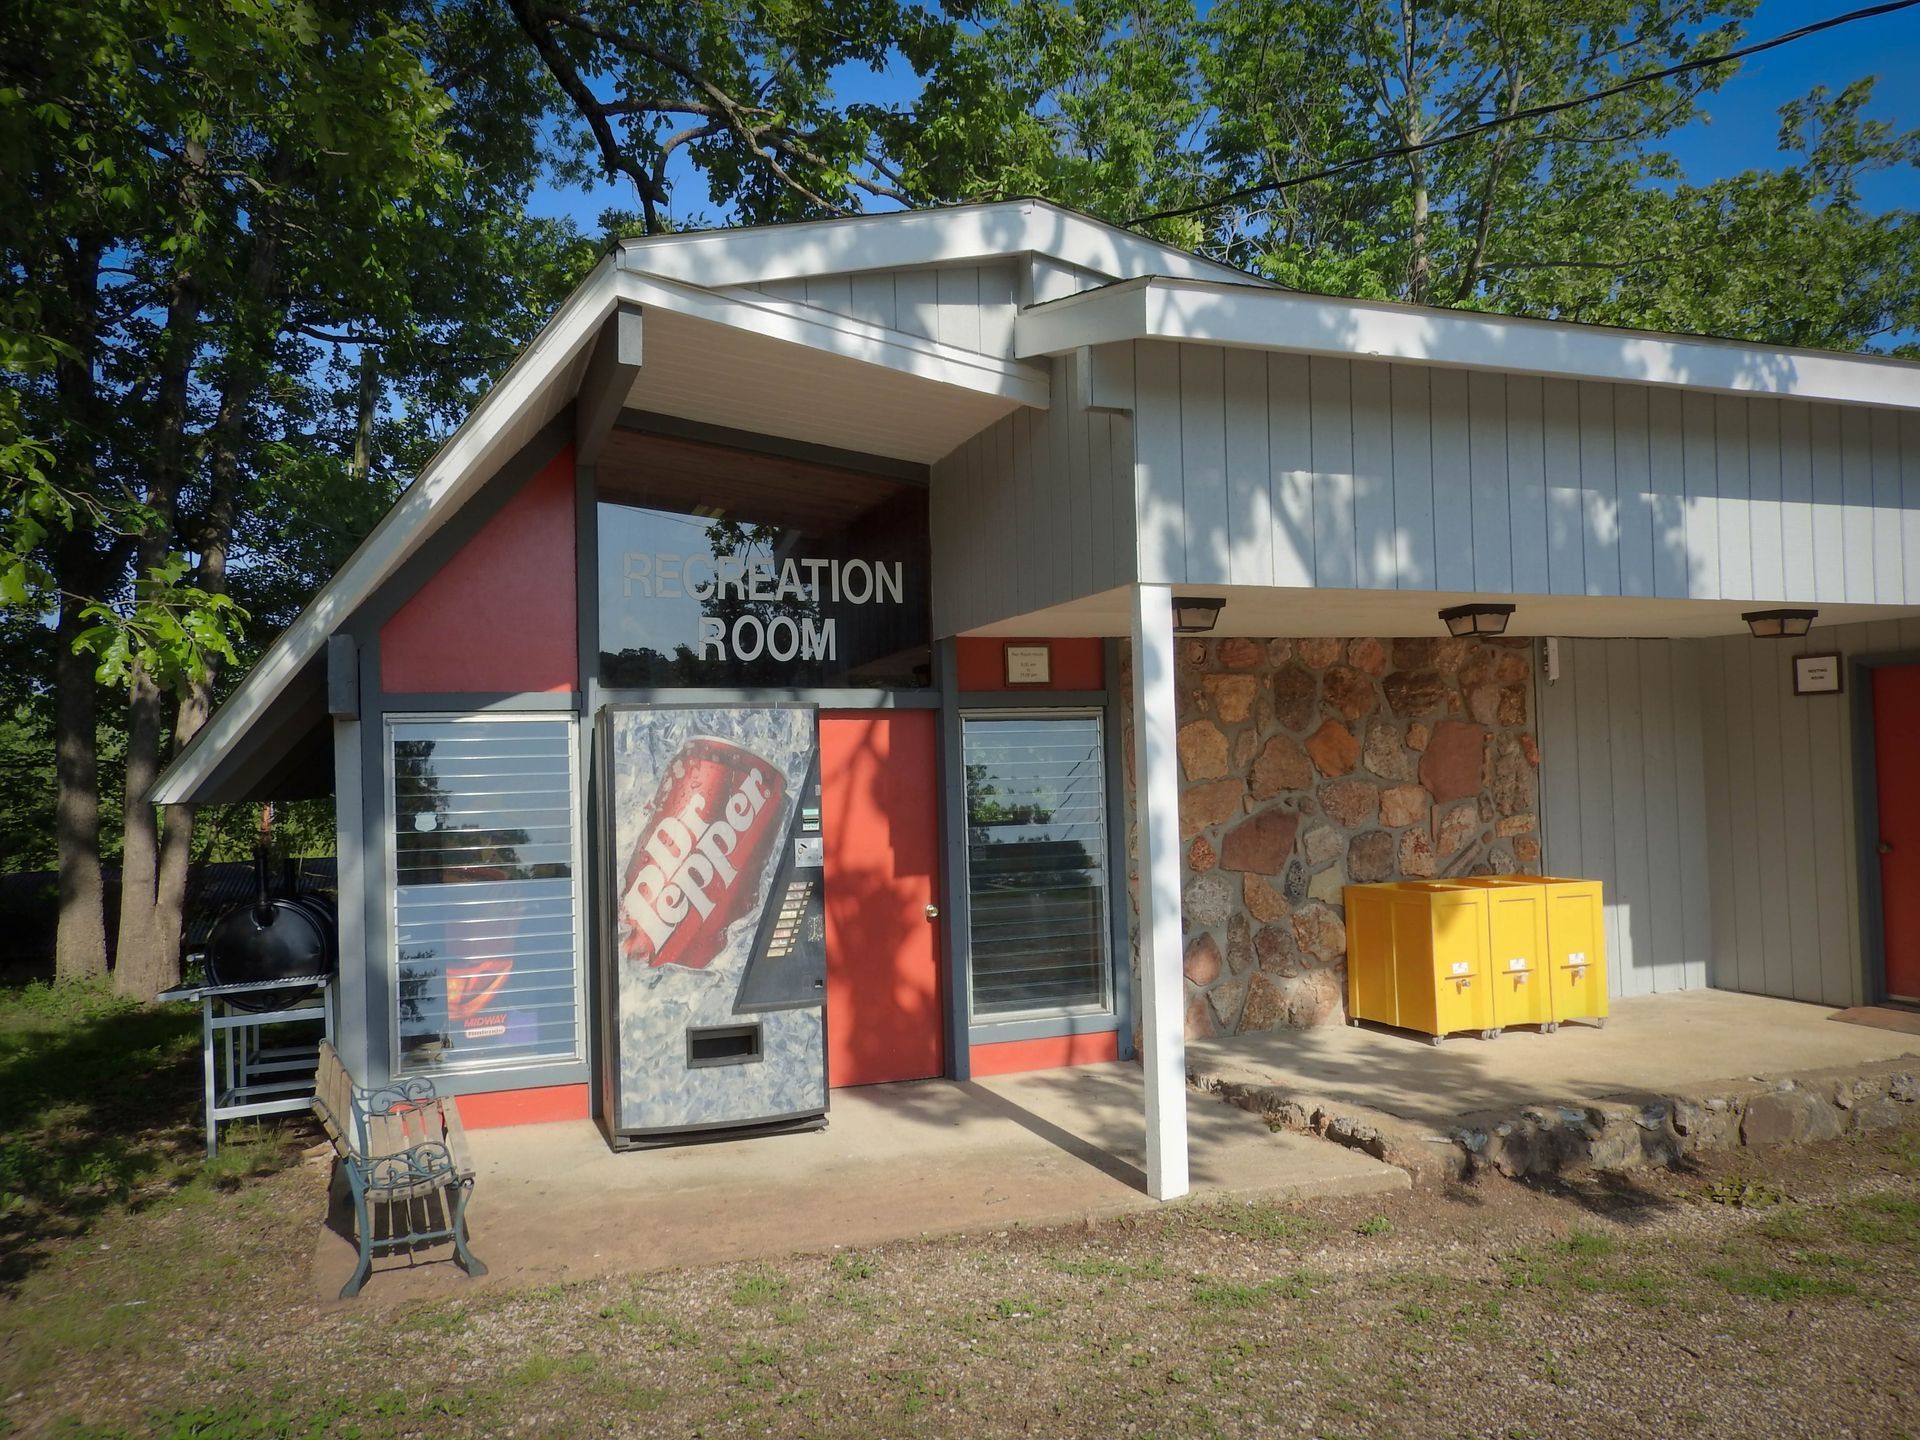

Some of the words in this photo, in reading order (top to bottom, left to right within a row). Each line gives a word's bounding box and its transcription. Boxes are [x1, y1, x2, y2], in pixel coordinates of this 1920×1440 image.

[623, 552, 904, 605] RECREATION
[697, 615, 837, 662] ROOM
[624, 767, 767, 954] Pepper
[644, 793, 711, 879] Dr
[464, 1014, 507, 1027] MIDWAY
